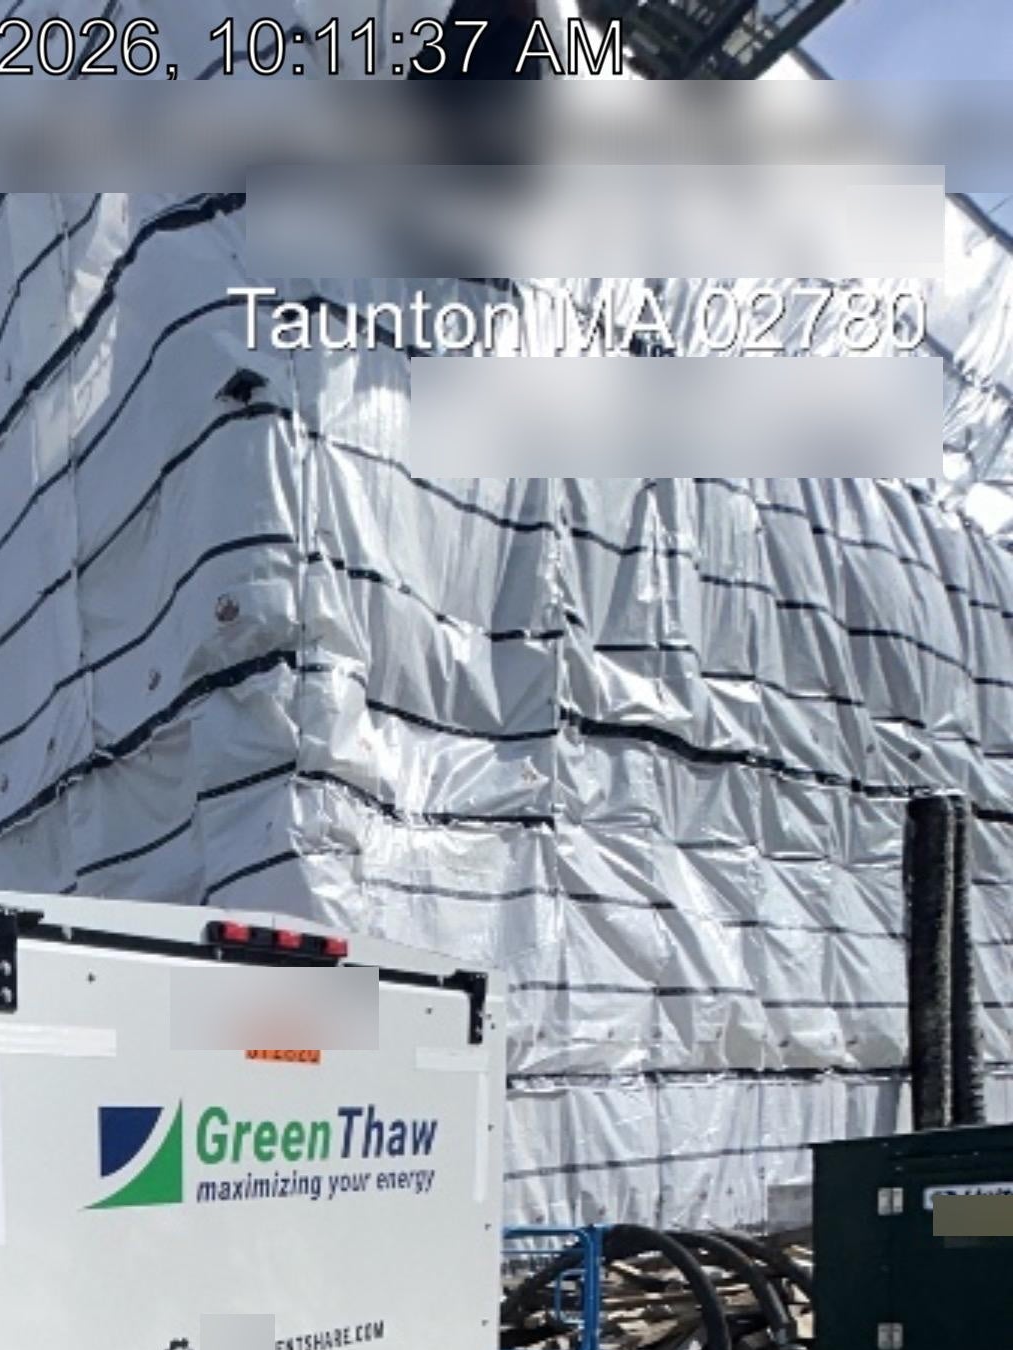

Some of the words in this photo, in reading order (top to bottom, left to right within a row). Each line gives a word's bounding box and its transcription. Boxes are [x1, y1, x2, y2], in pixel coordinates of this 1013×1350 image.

[196, 1170, 322, 1203] maximizing
[329, 1171, 371, 1200] your
[376, 1169, 435, 1195] energy
